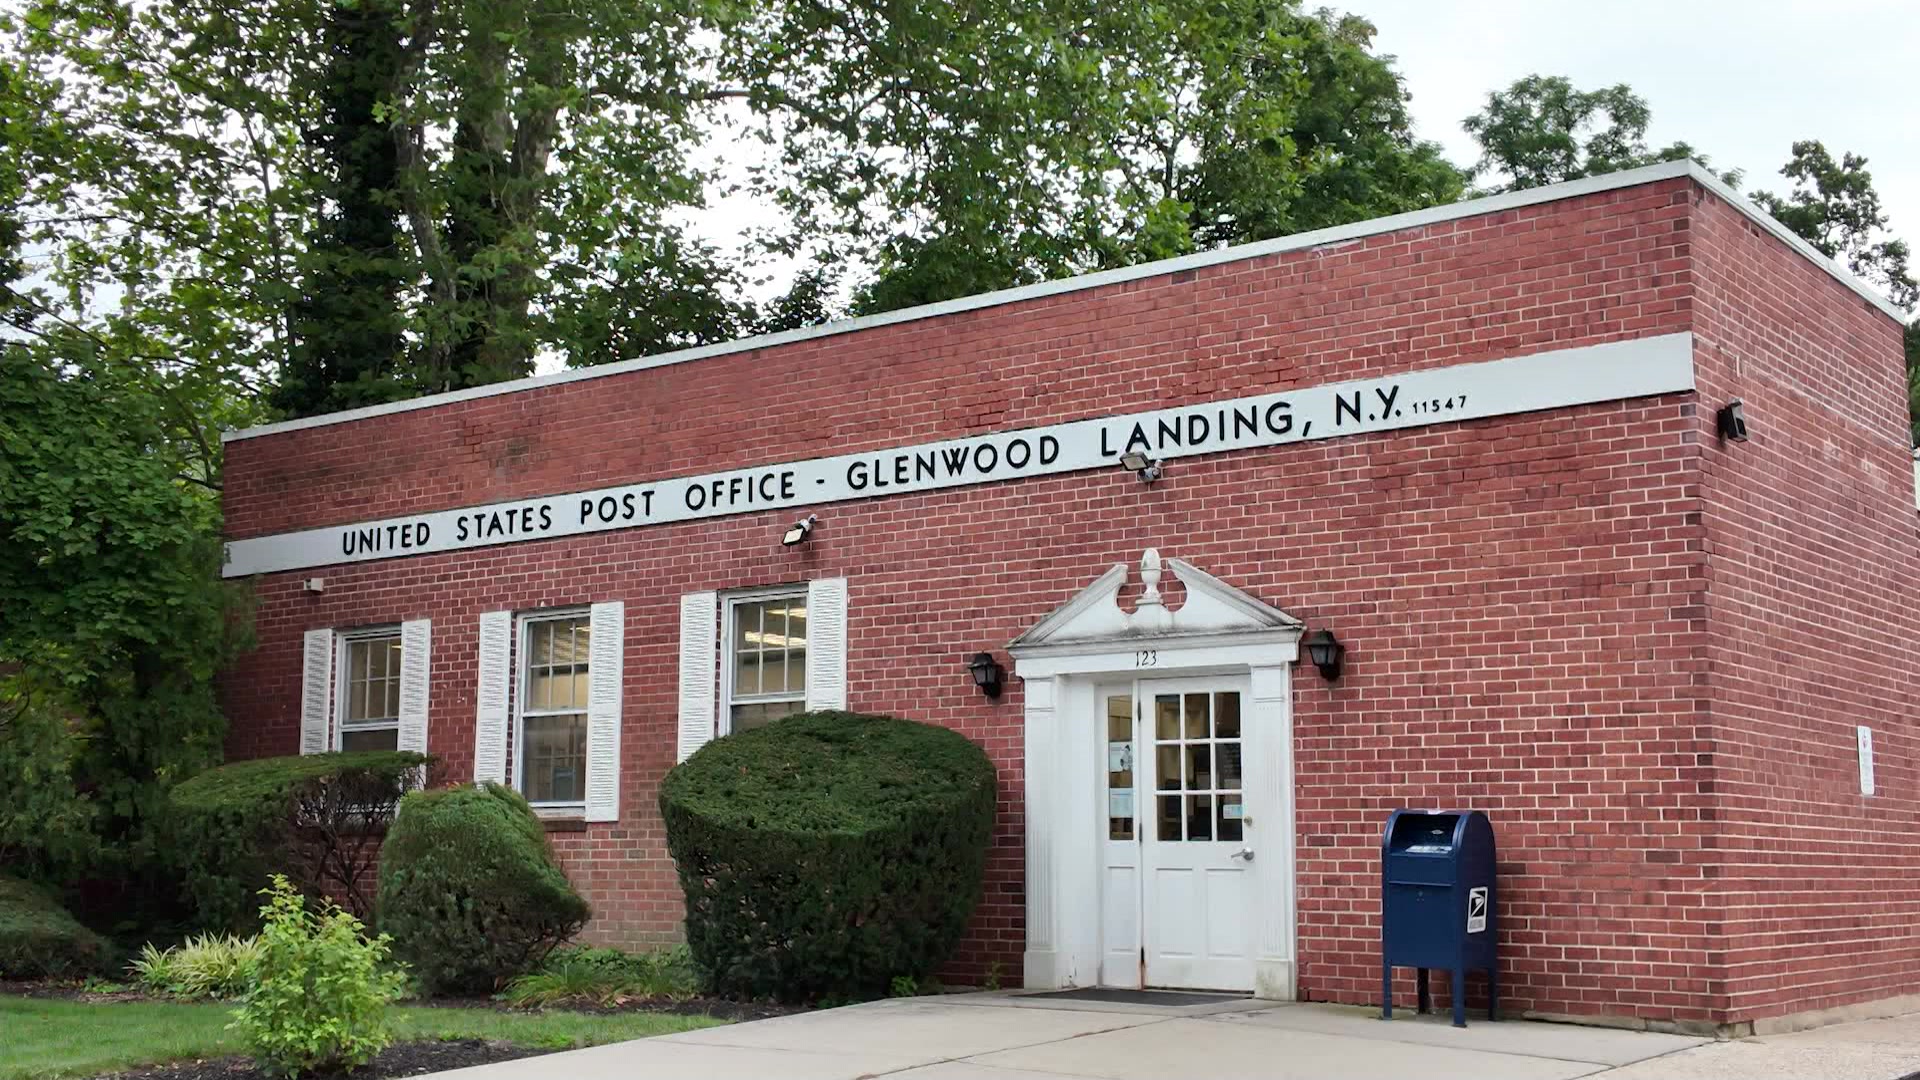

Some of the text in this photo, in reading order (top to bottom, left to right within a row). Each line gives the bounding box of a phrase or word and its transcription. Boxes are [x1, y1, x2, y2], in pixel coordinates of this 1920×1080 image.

[342, 522, 431, 556] UNITED
[456, 504, 552, 542] STATES
[580, 490, 655, 525] POST
[685, 470, 796, 511] OFFICE
[846, 434, 1060, 491] GLENWOOD
[1100, 401, 1312, 458] LANDING,
[1335, 384, 1403, 427] N.Y.
[1412, 394, 1468, 415] 11547
[1136, 650, 1157, 667] 123
